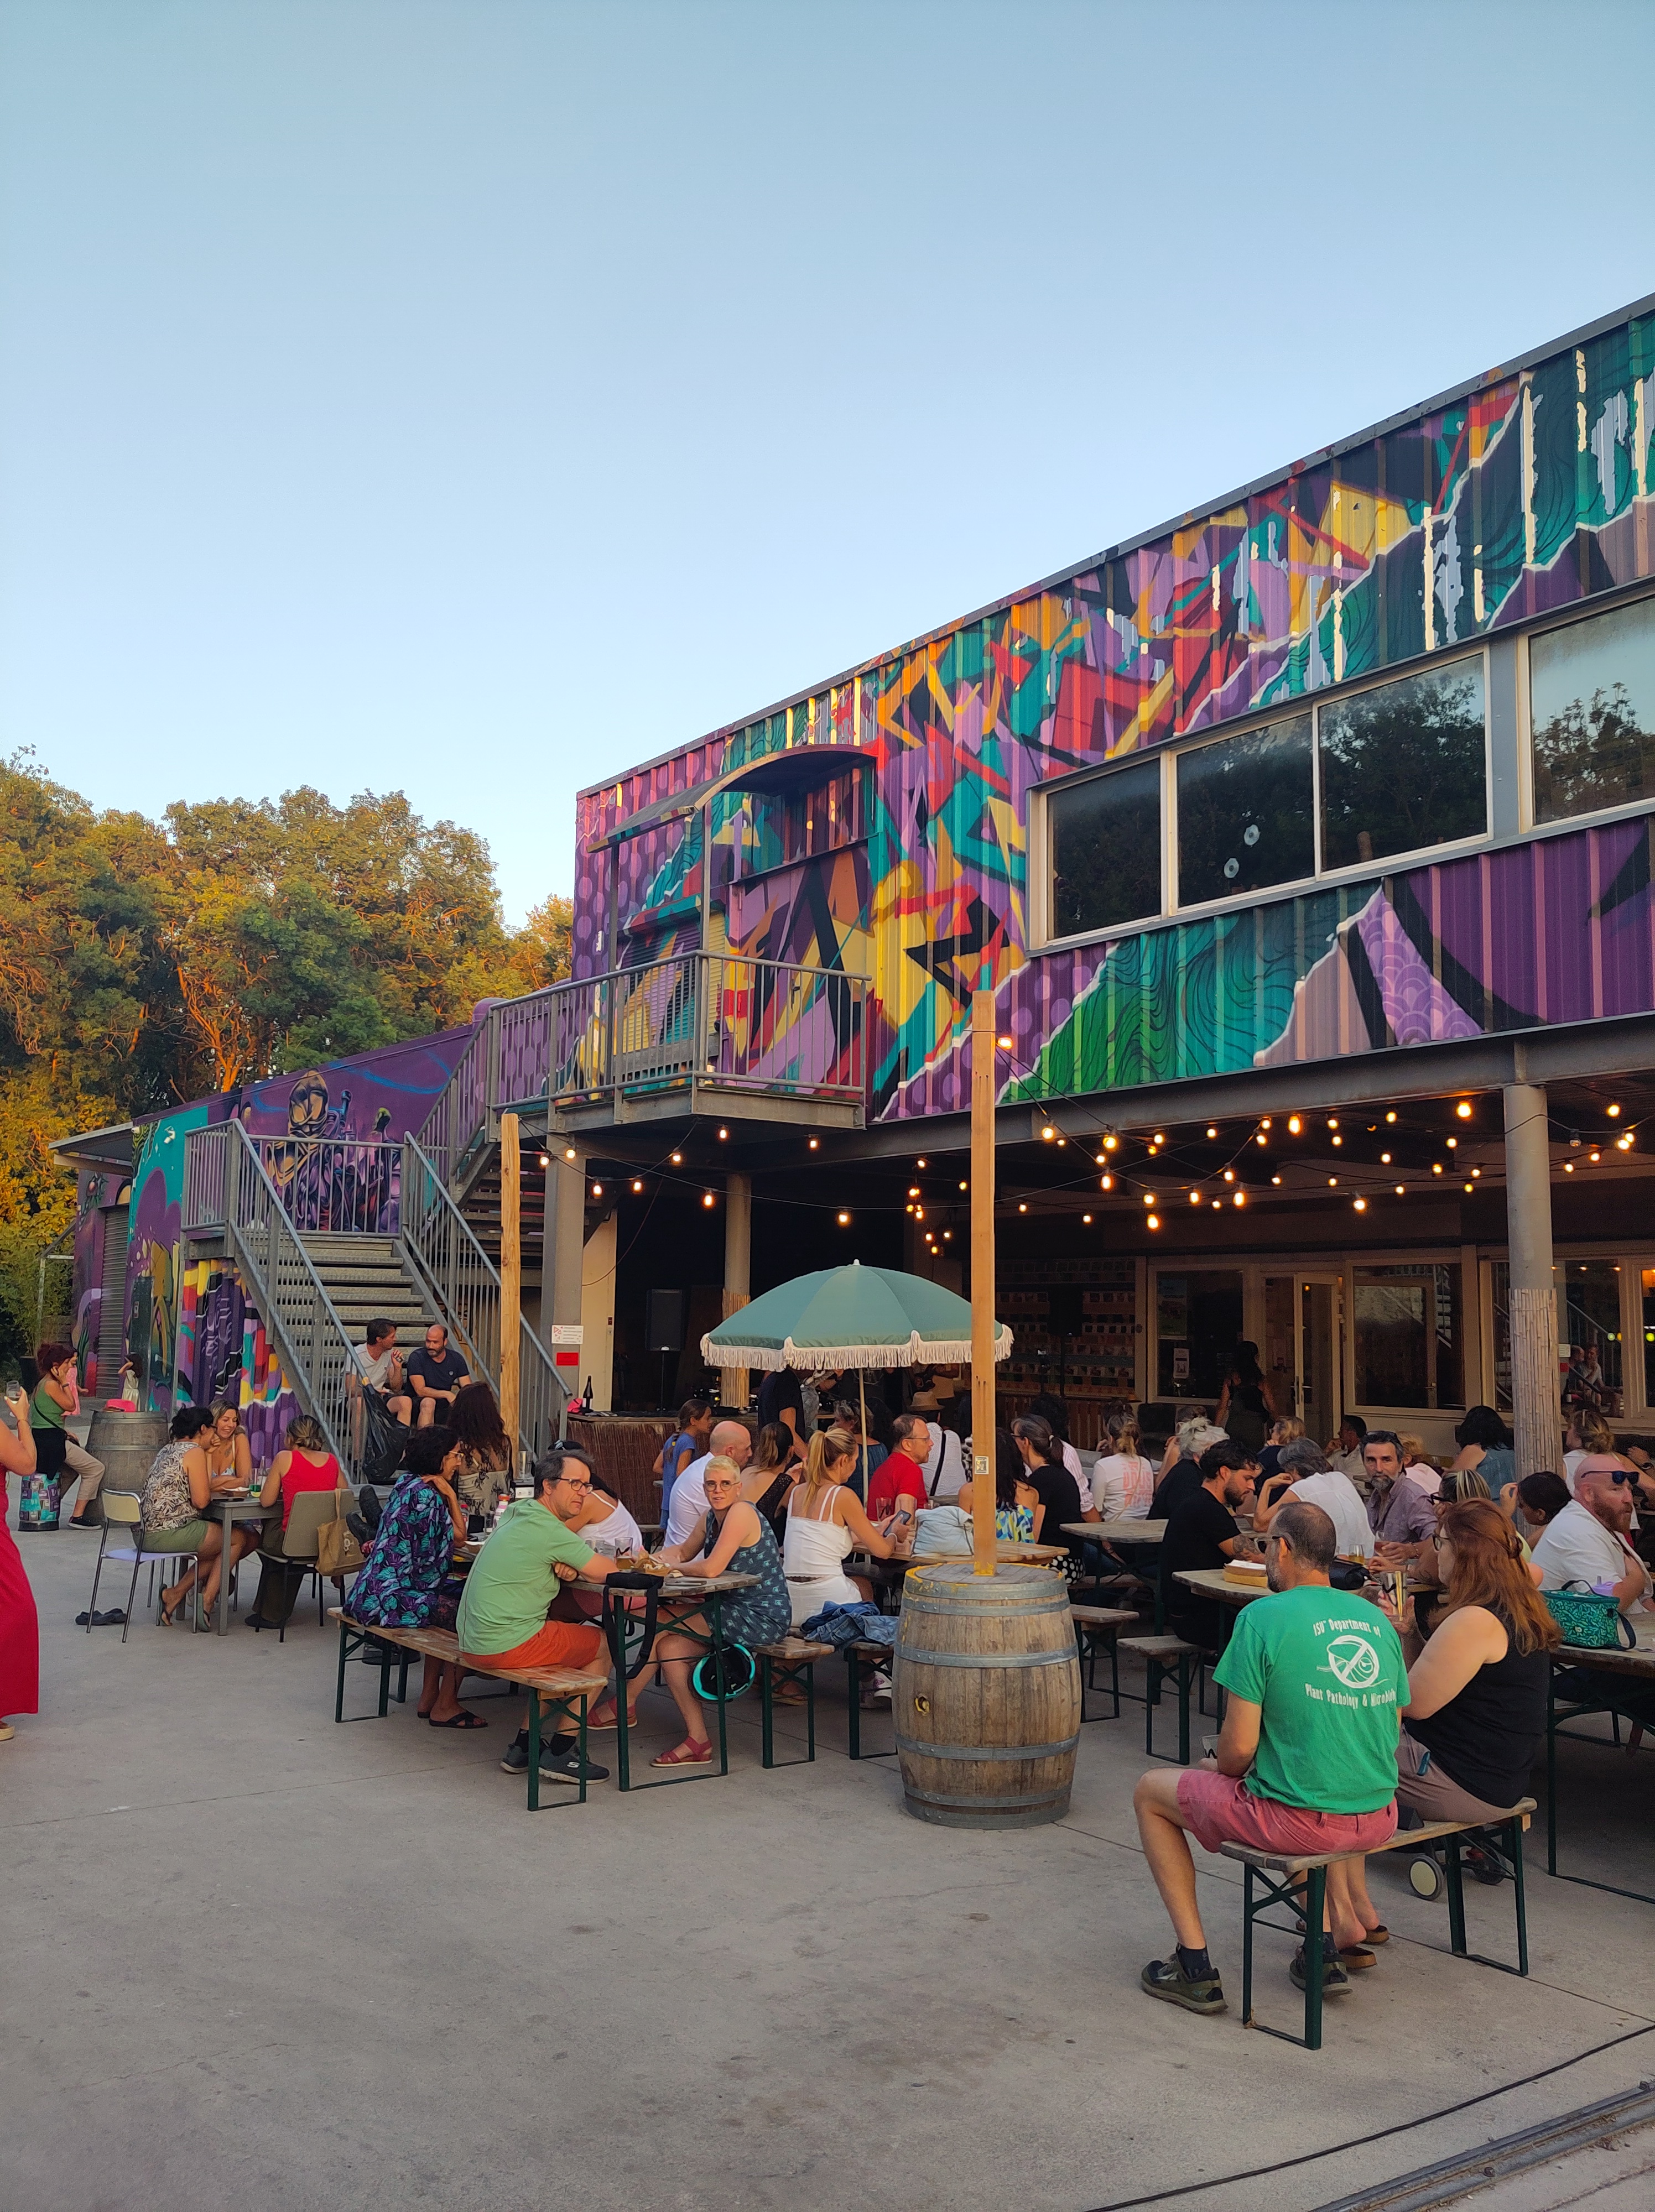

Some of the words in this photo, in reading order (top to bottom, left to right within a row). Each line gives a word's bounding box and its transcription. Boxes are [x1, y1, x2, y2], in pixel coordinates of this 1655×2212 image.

[1328, 1618, 1372, 1633] Department
[1373, 1625, 1382, 1639] of
[1305, 1683, 1324, 1700] Plant
[1326, 1689, 1359, 1710] Pathology
[1362, 1693, 1368, 1707] &
